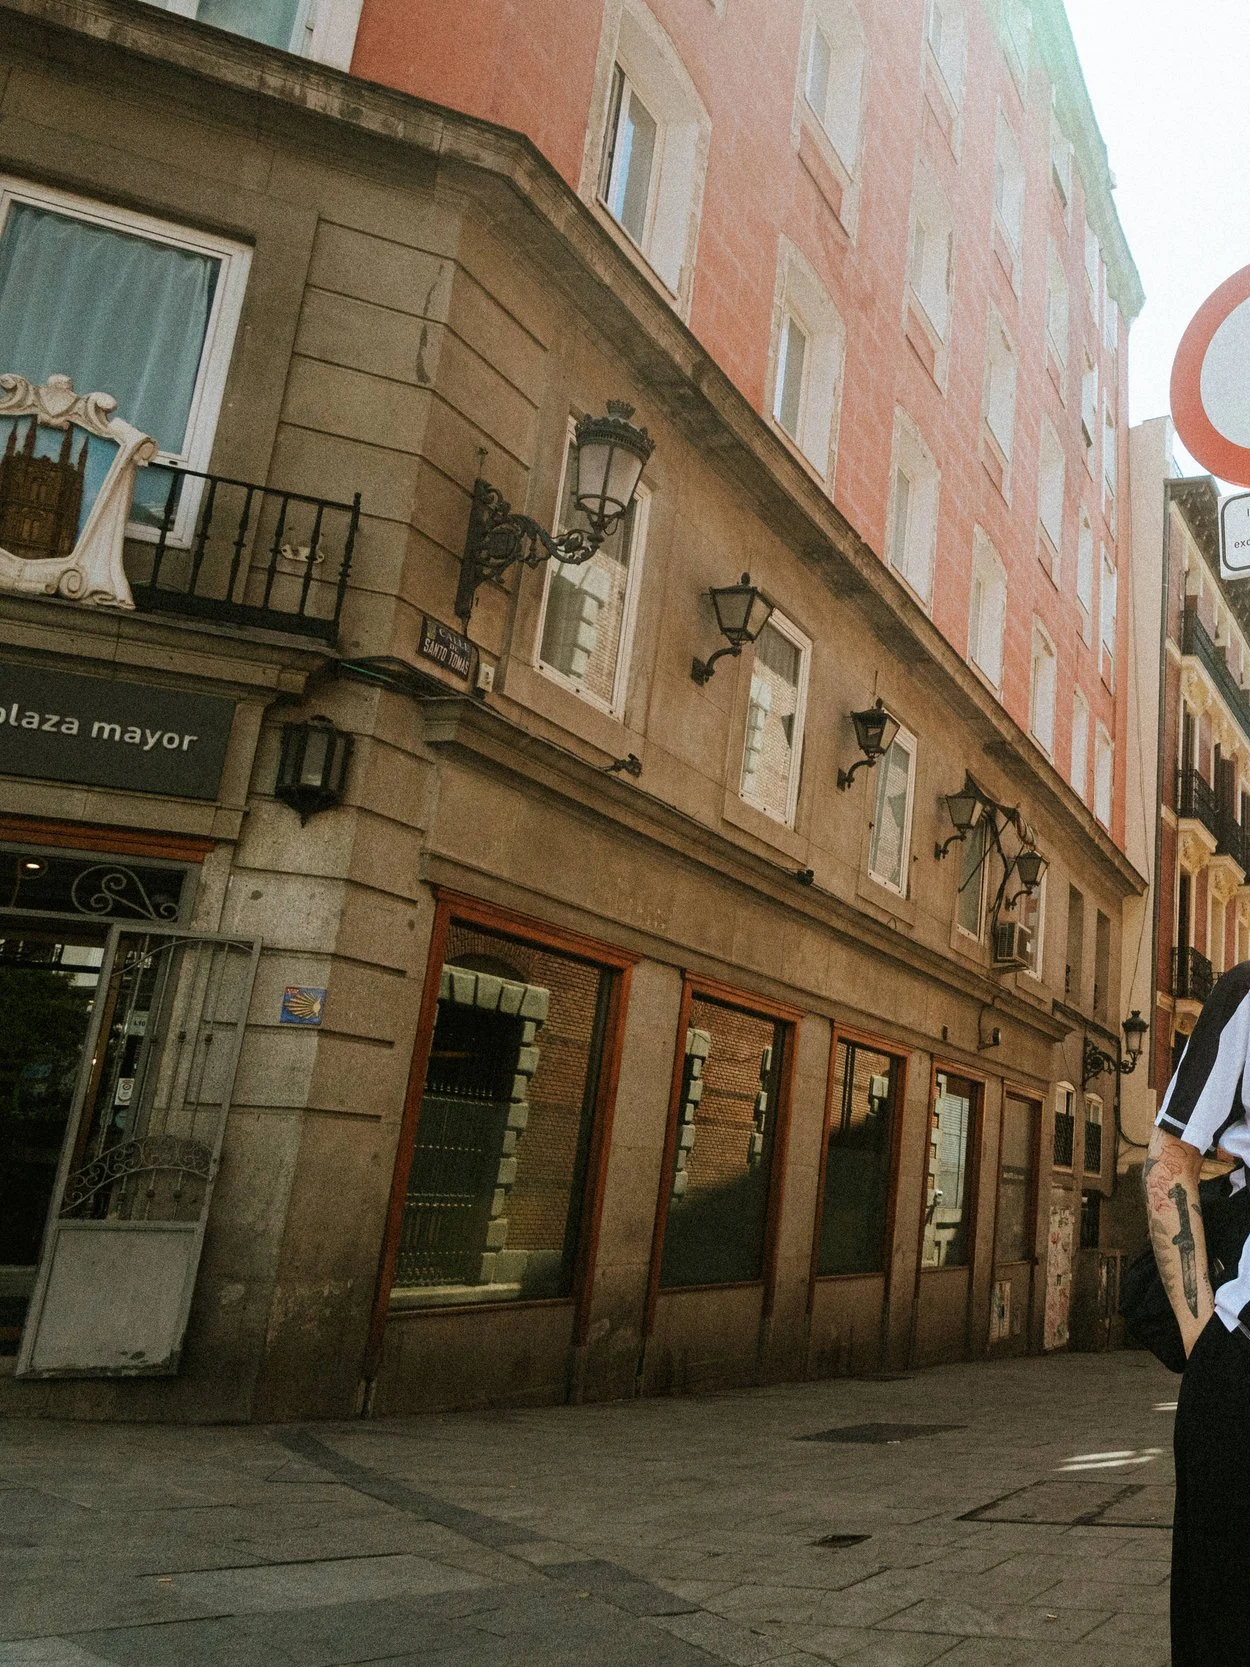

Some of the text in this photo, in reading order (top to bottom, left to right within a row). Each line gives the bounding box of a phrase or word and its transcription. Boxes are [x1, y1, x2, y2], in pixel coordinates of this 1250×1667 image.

[423, 637, 447, 661] SANTO
[438, 628, 470, 653] CALLE
[449, 642, 458, 652] DE
[91, 720, 198, 752] mayor
